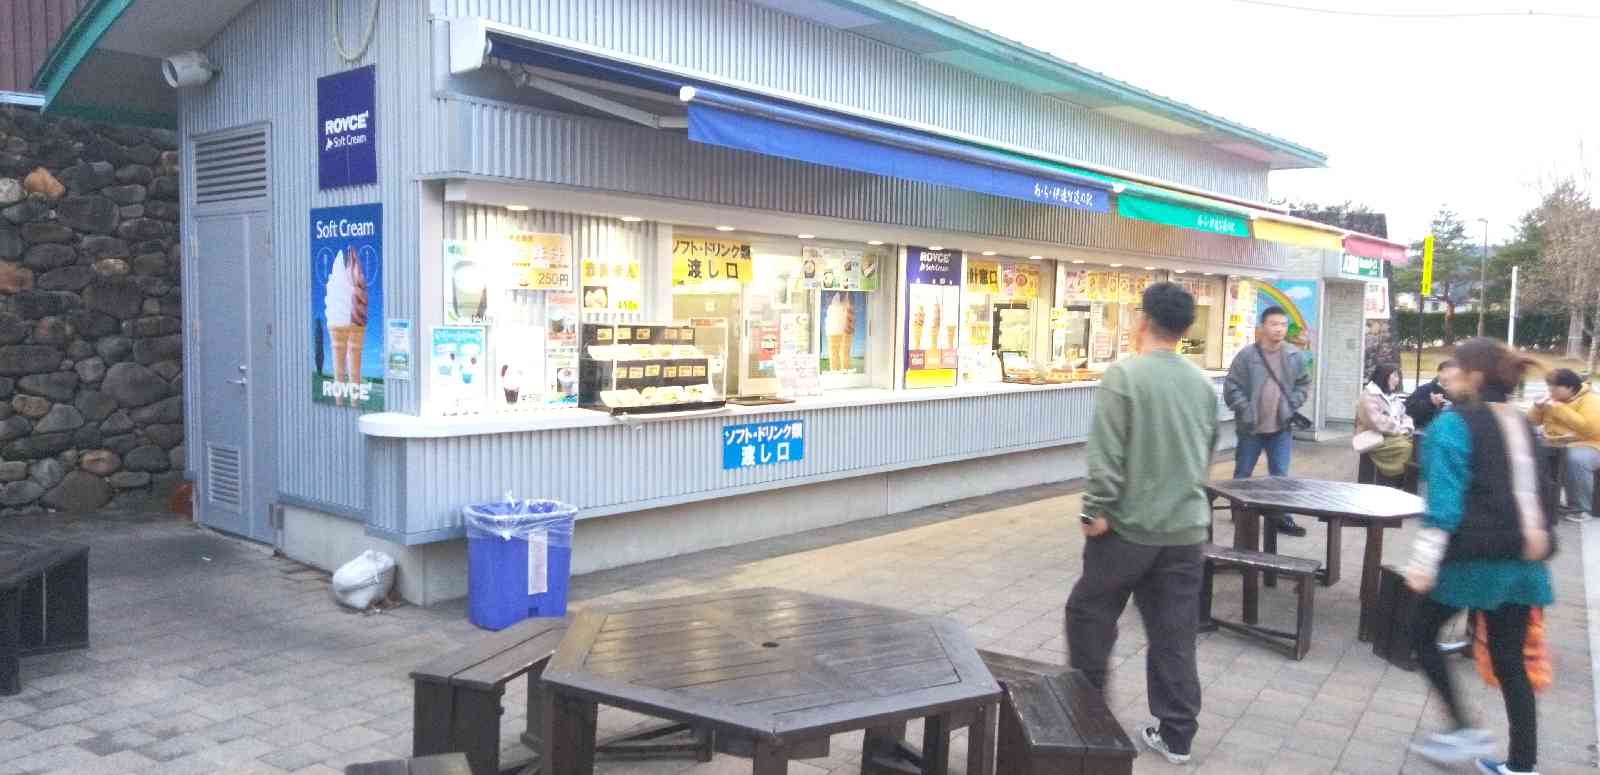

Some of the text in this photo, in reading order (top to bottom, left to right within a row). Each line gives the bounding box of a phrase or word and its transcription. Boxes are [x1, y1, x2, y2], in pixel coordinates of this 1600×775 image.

[316, 218, 374, 239] Soft Cream
[687, 257, 739, 279] 渡し口
[741, 442, 790, 466] 渡し口
